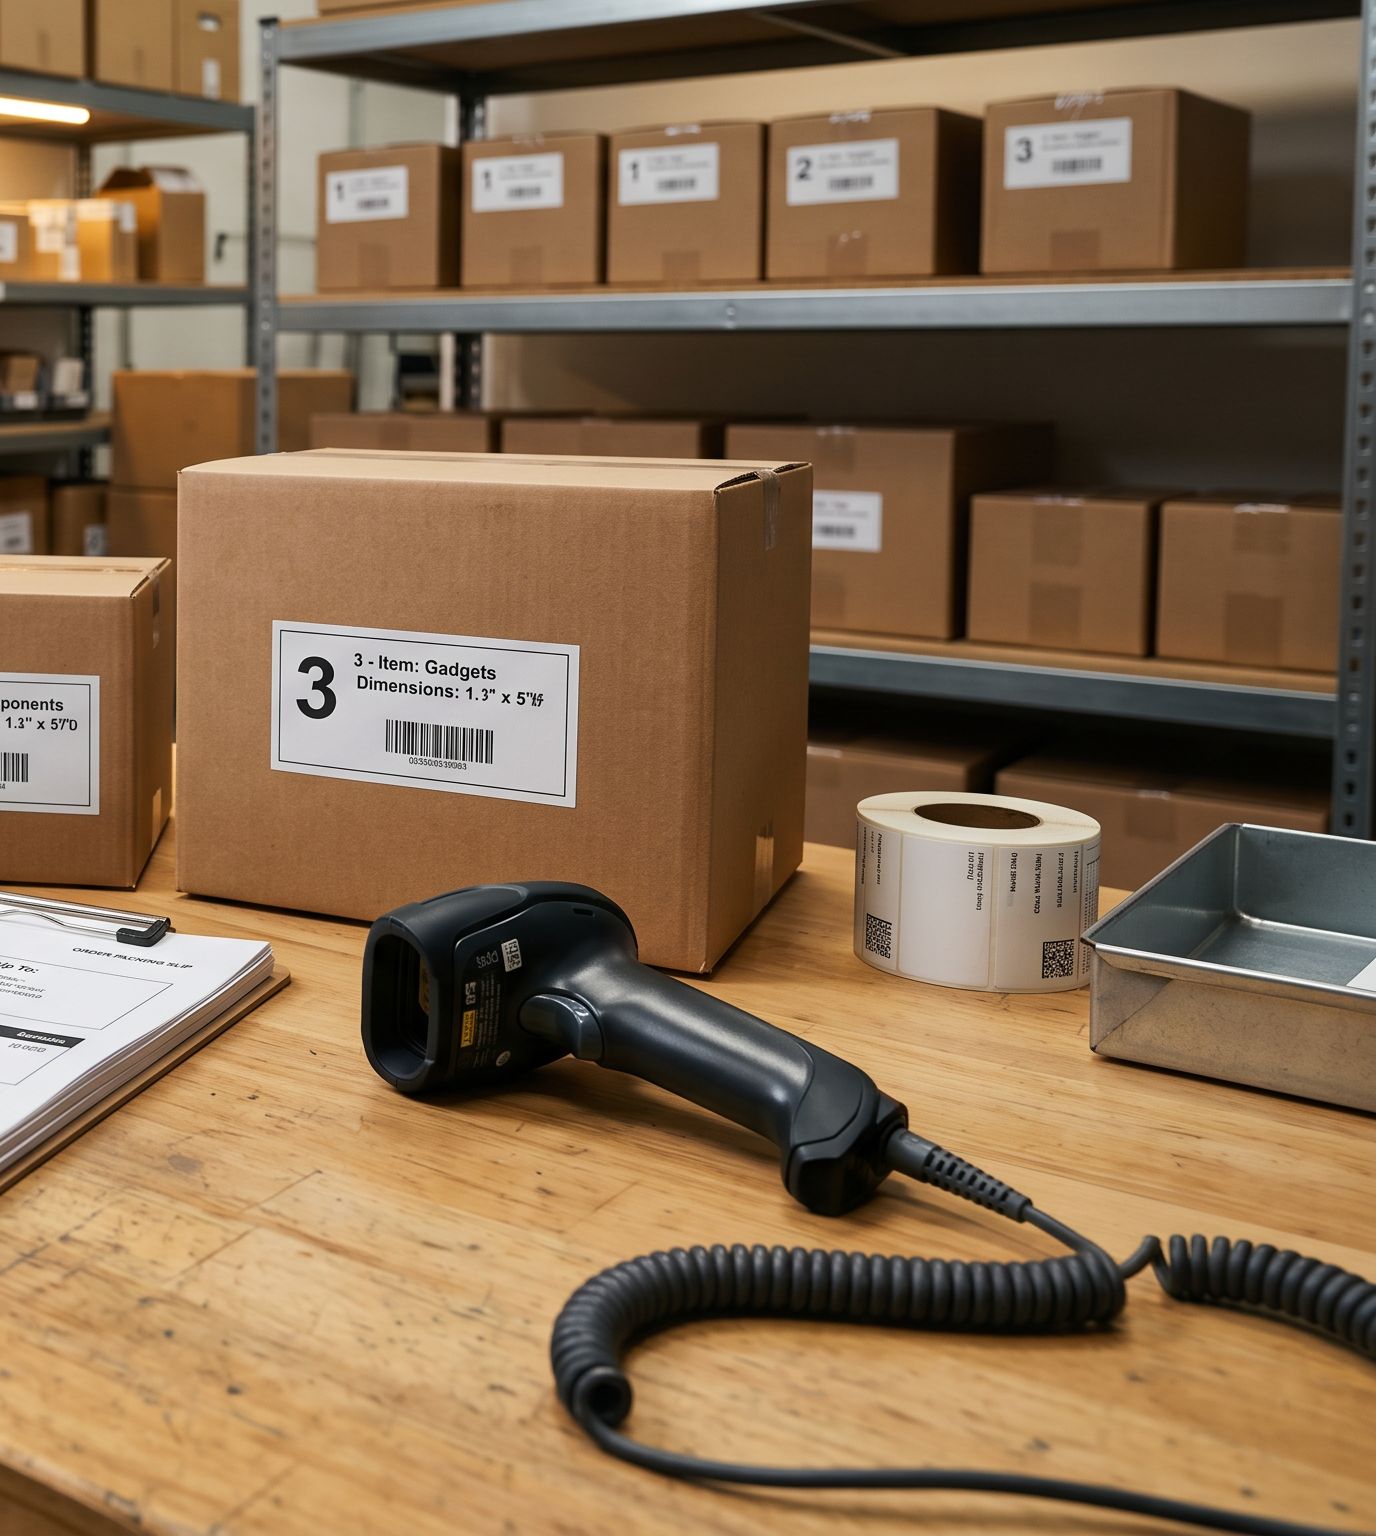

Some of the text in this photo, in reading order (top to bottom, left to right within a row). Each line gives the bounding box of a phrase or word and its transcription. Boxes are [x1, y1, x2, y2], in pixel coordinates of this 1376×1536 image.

[1015, 136, 1032, 163] 3
[795, 156, 811, 181] 2
[352, 653, 363, 667] 3
[378, 655, 419, 673] Item:
[424, 659, 497, 682] Gadgets
[295, 656, 337, 720] 3
[356, 675, 460, 699] Dimensions:
[501, 693, 511, 704] x
[36, 720, 46, 730] x
